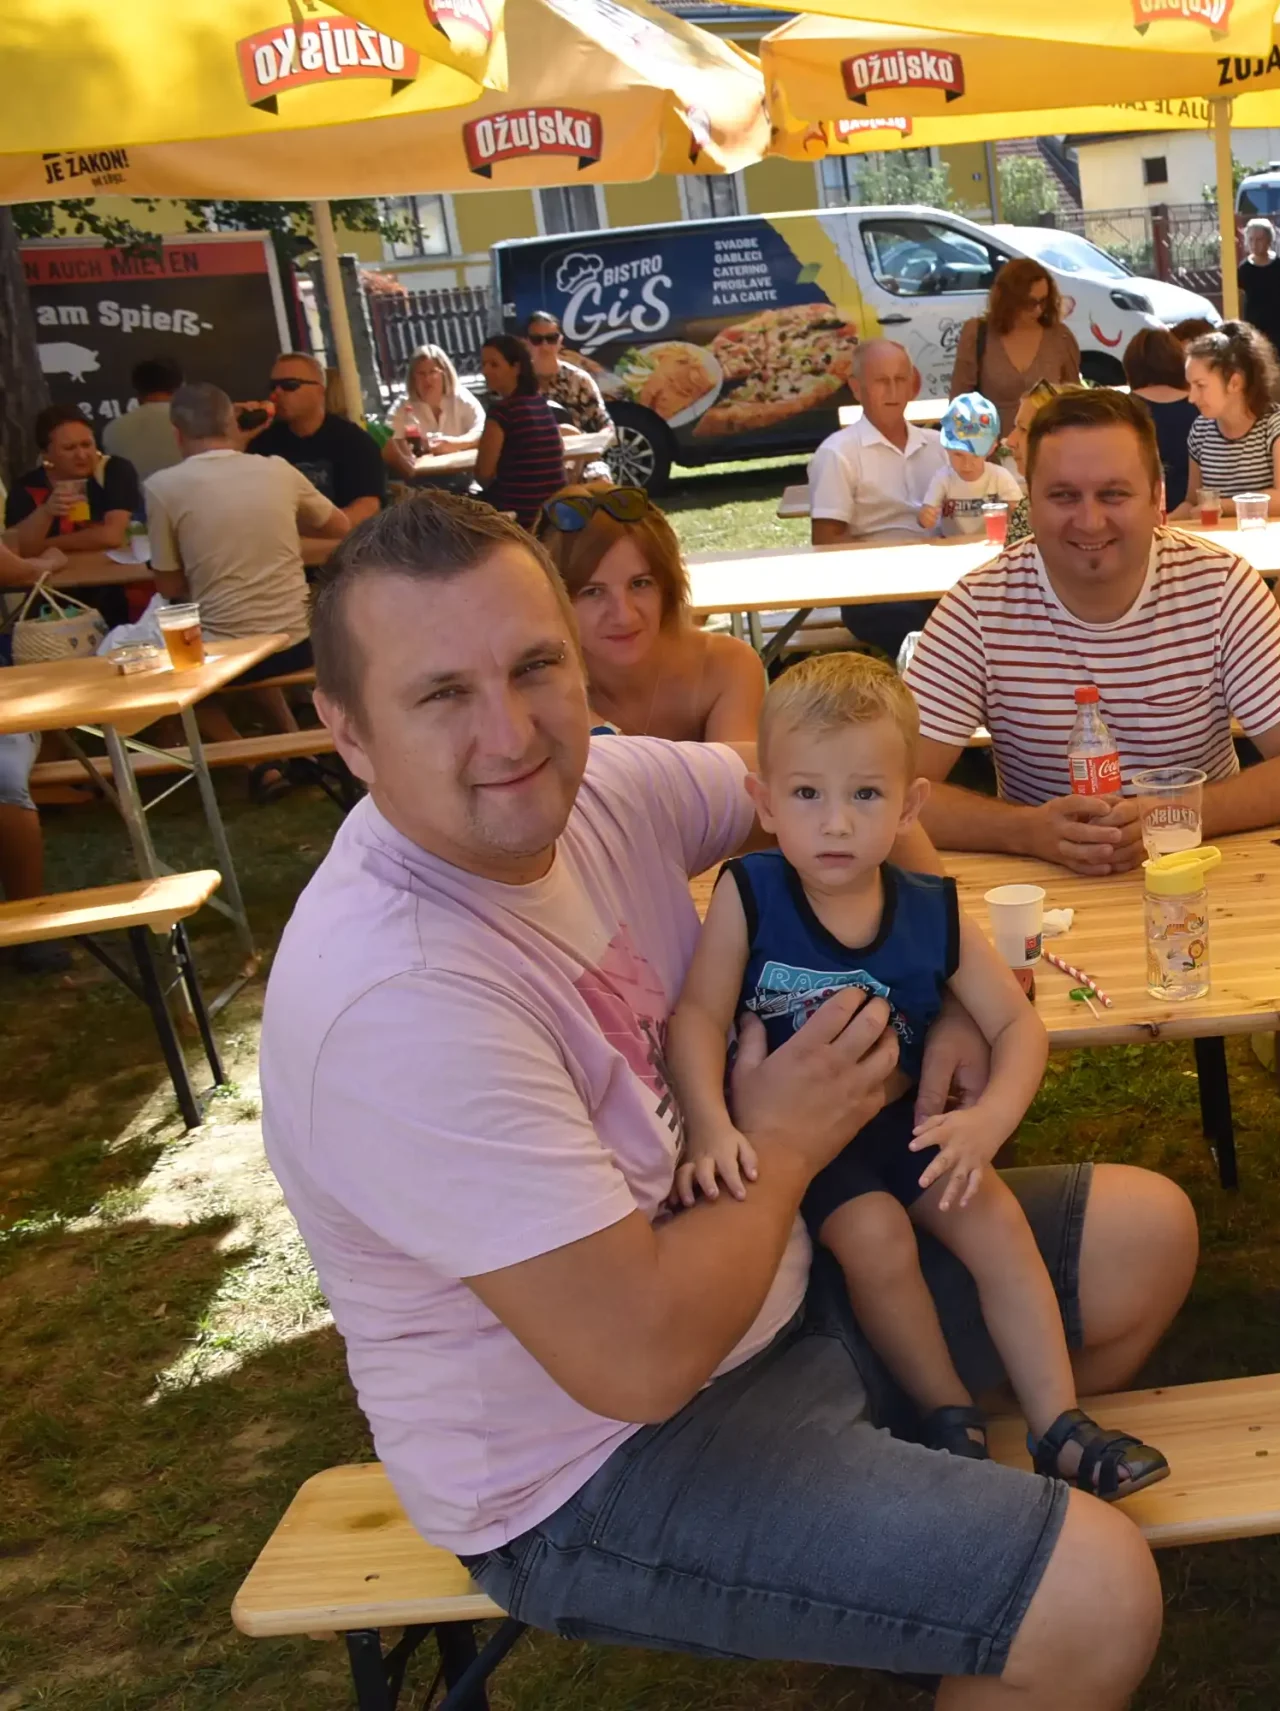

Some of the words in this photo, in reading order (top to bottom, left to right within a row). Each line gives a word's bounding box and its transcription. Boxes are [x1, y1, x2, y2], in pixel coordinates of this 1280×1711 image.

[852, 50, 954, 89] Ožujsko
[475, 109, 593, 158] Ožujsko
[45, 161, 65, 184] JE
[714, 237, 759, 251] SVADBE
[50, 260, 102, 278] AUCH
[603, 254, 663, 287] BISTRO
[713, 276, 773, 291] PROSLAVE
[712, 294, 721, 306] A
[722, 293, 739, 304] LA
[740, 289, 778, 303] CARTE
[37, 305, 90, 326] am
